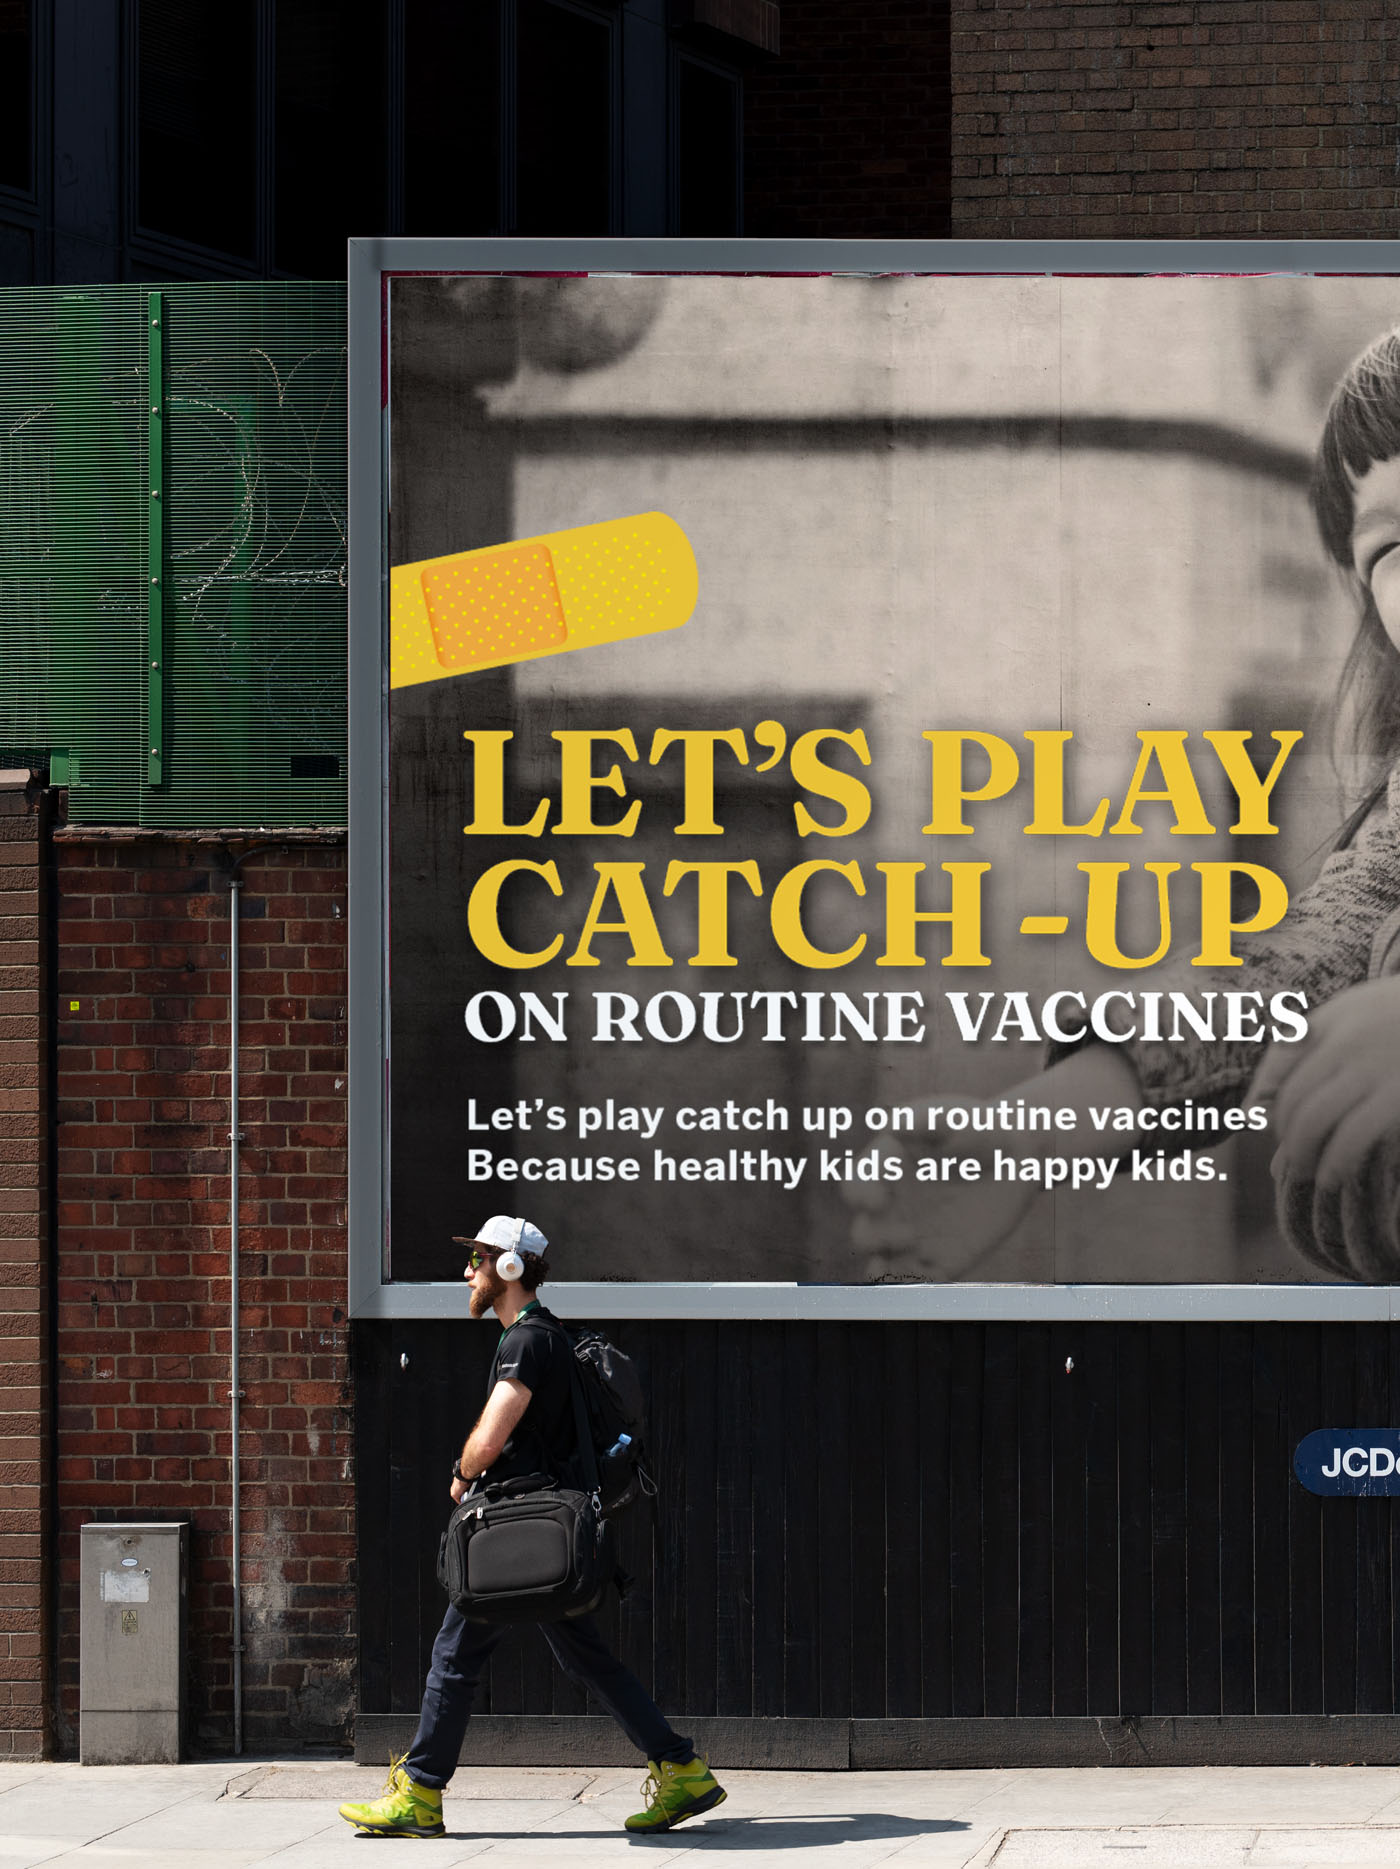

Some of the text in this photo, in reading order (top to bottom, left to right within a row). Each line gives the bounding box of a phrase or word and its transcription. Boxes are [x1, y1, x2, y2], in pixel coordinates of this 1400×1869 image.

[463, 720, 1305, 838] LET’S PLAY
[465, 991, 1308, 1043] ON ROUTINE VACCINES
[468, 1098, 1268, 1139] Let’s play catch up on routine vaccines
[468, 1149, 1227, 1189] Because healthy kids are happy kids.
